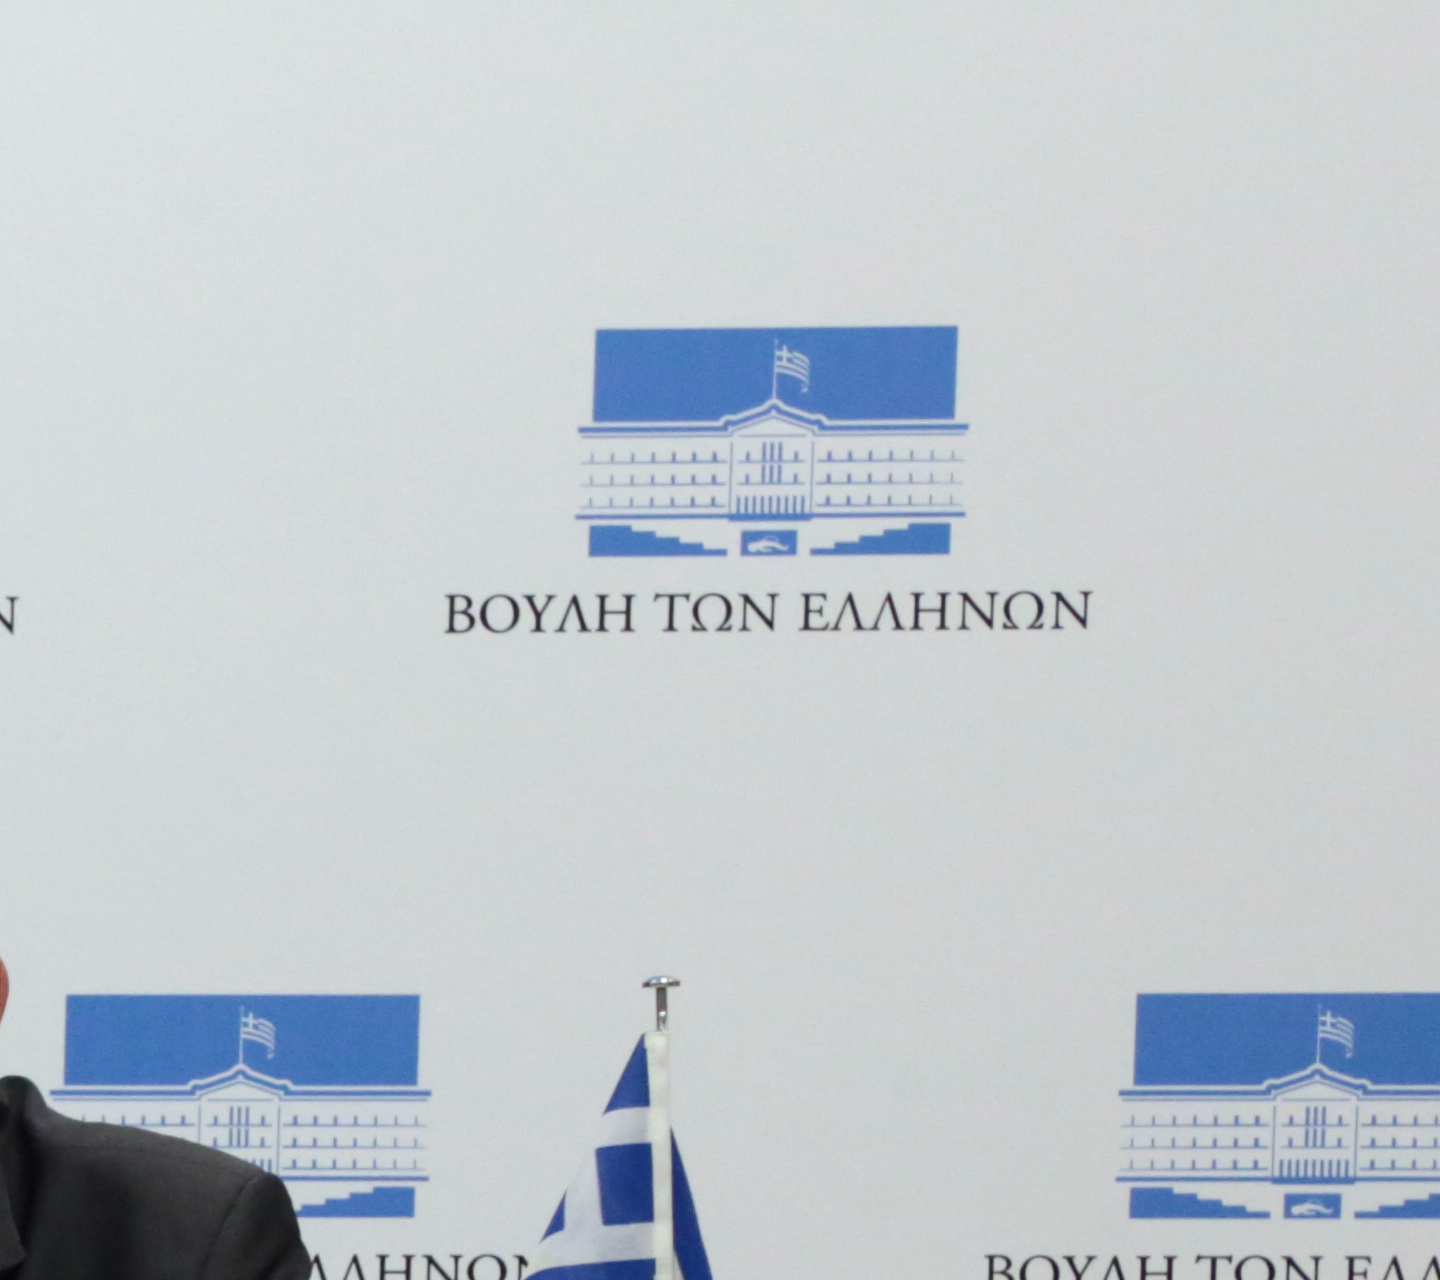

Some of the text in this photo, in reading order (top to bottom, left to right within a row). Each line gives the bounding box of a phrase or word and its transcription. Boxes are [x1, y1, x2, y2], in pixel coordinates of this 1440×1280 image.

[445, 590, 1092, 635] ΒΟΥΛΗ ΤΩΝ ΕΛΛΗΝΩΝ
